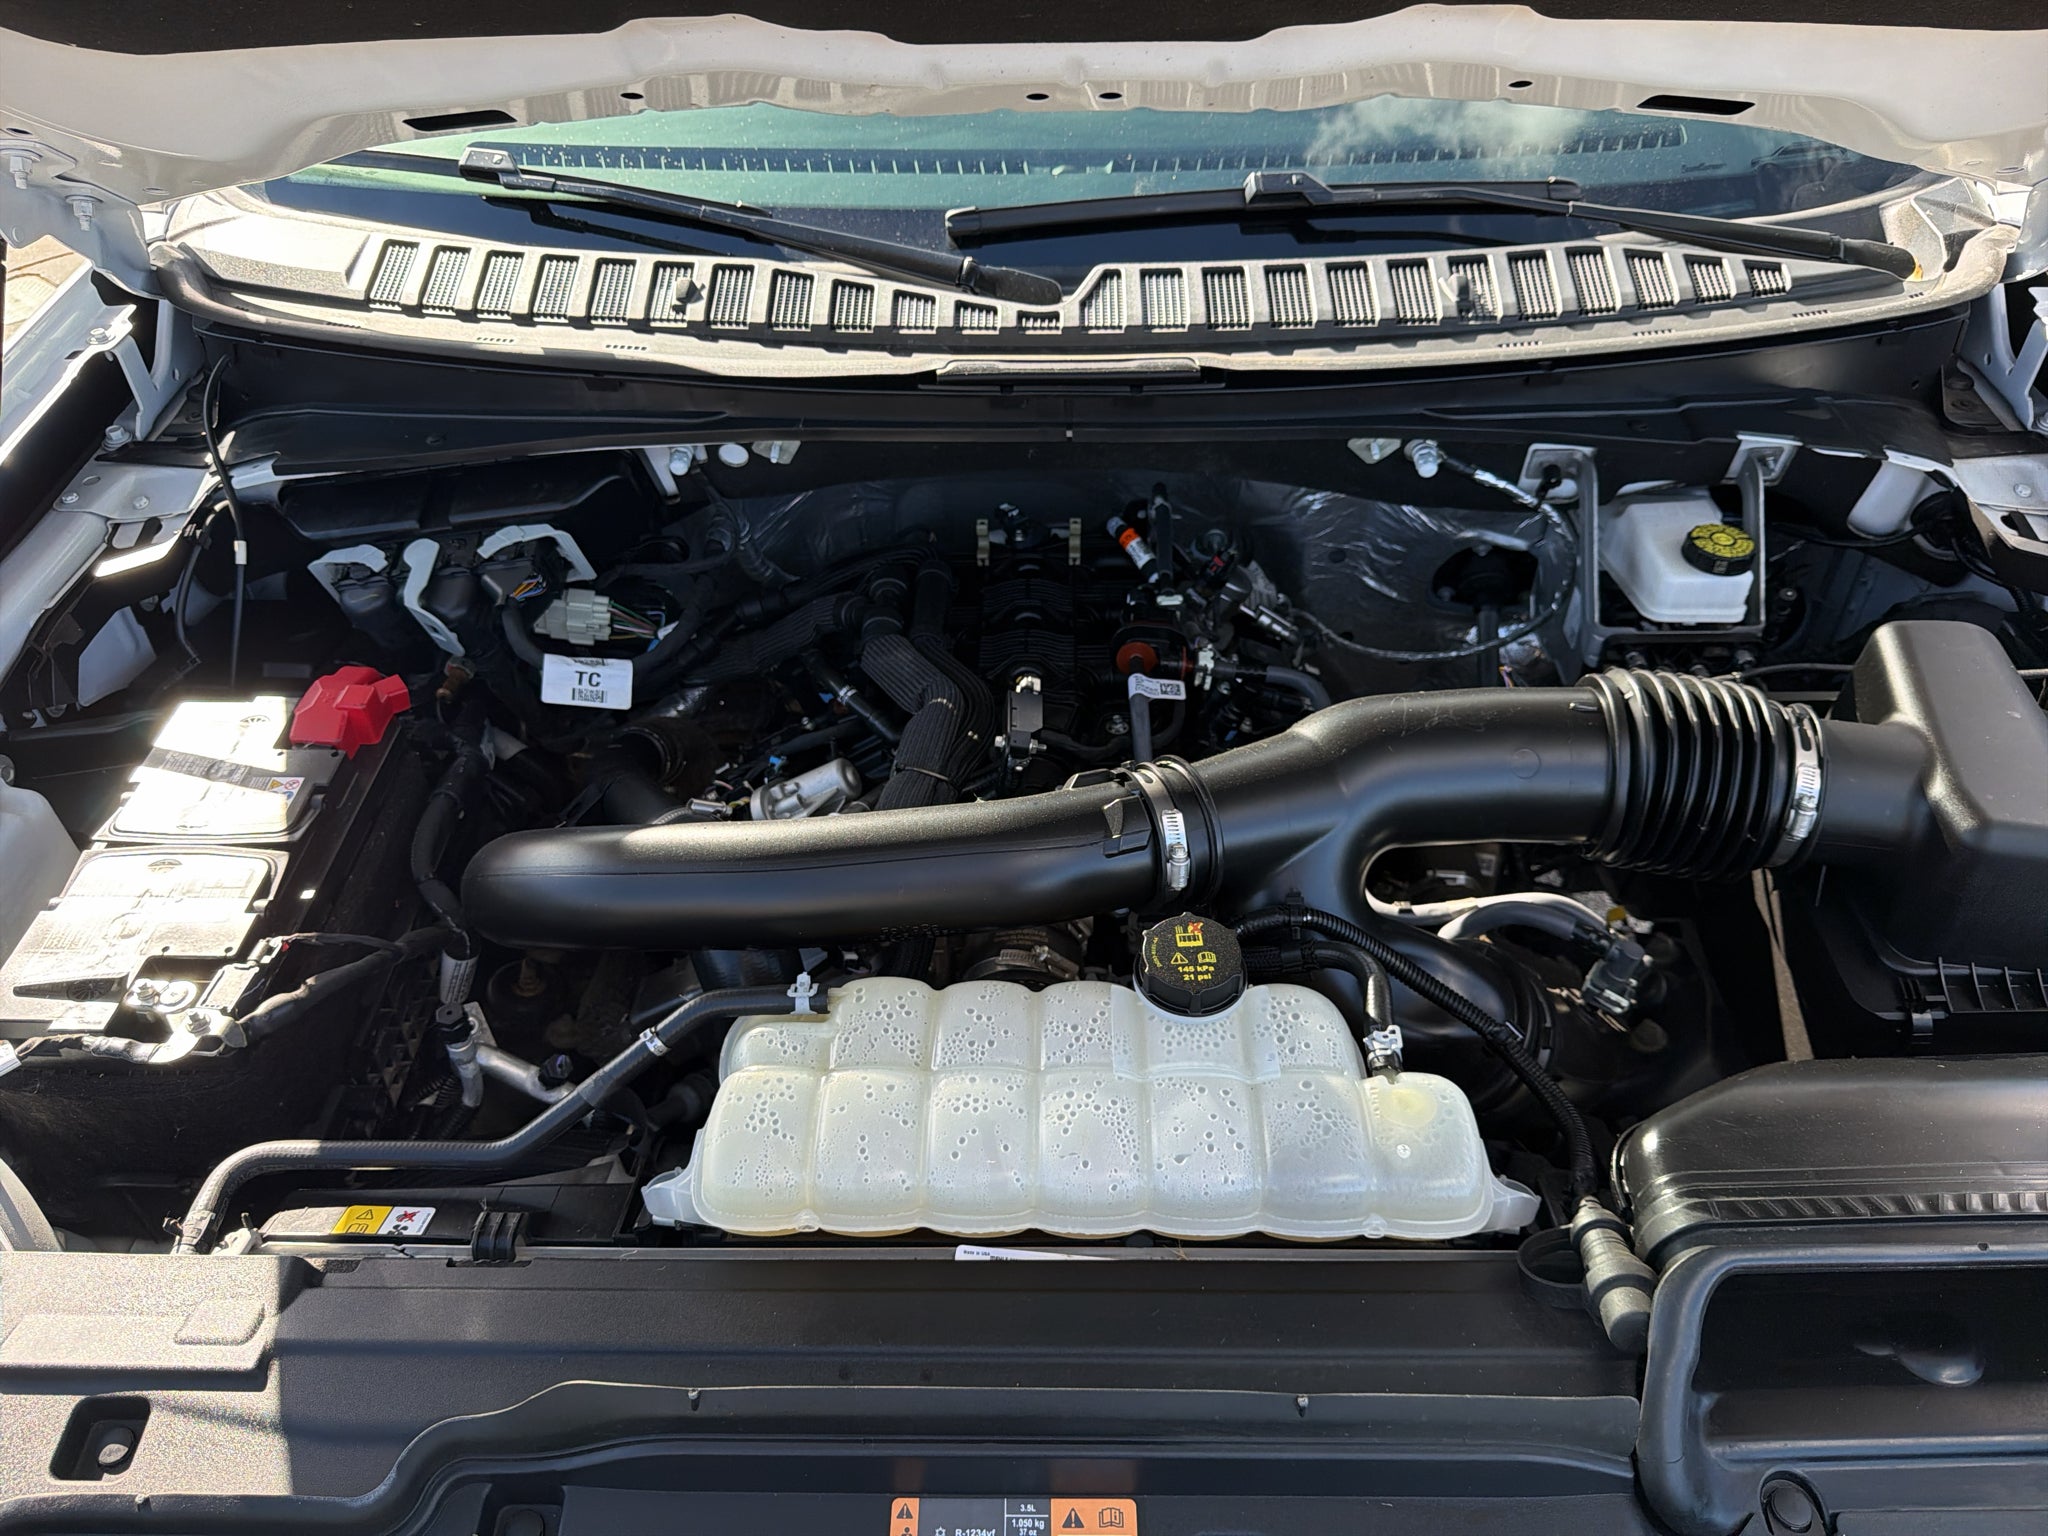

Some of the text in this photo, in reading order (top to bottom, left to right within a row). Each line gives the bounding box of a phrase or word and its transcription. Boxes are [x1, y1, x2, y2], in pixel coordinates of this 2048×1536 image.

[575, 671, 601, 687] TC
[1178, 965, 1195, 973] 145
[1183, 973, 1212, 981] 21 psi
[1020, 1504, 1036, 1512] 3.5L
[1012, 1518, 1045, 1529] 1.050 kg
[1019, 1528, 1027, 1536] 37
